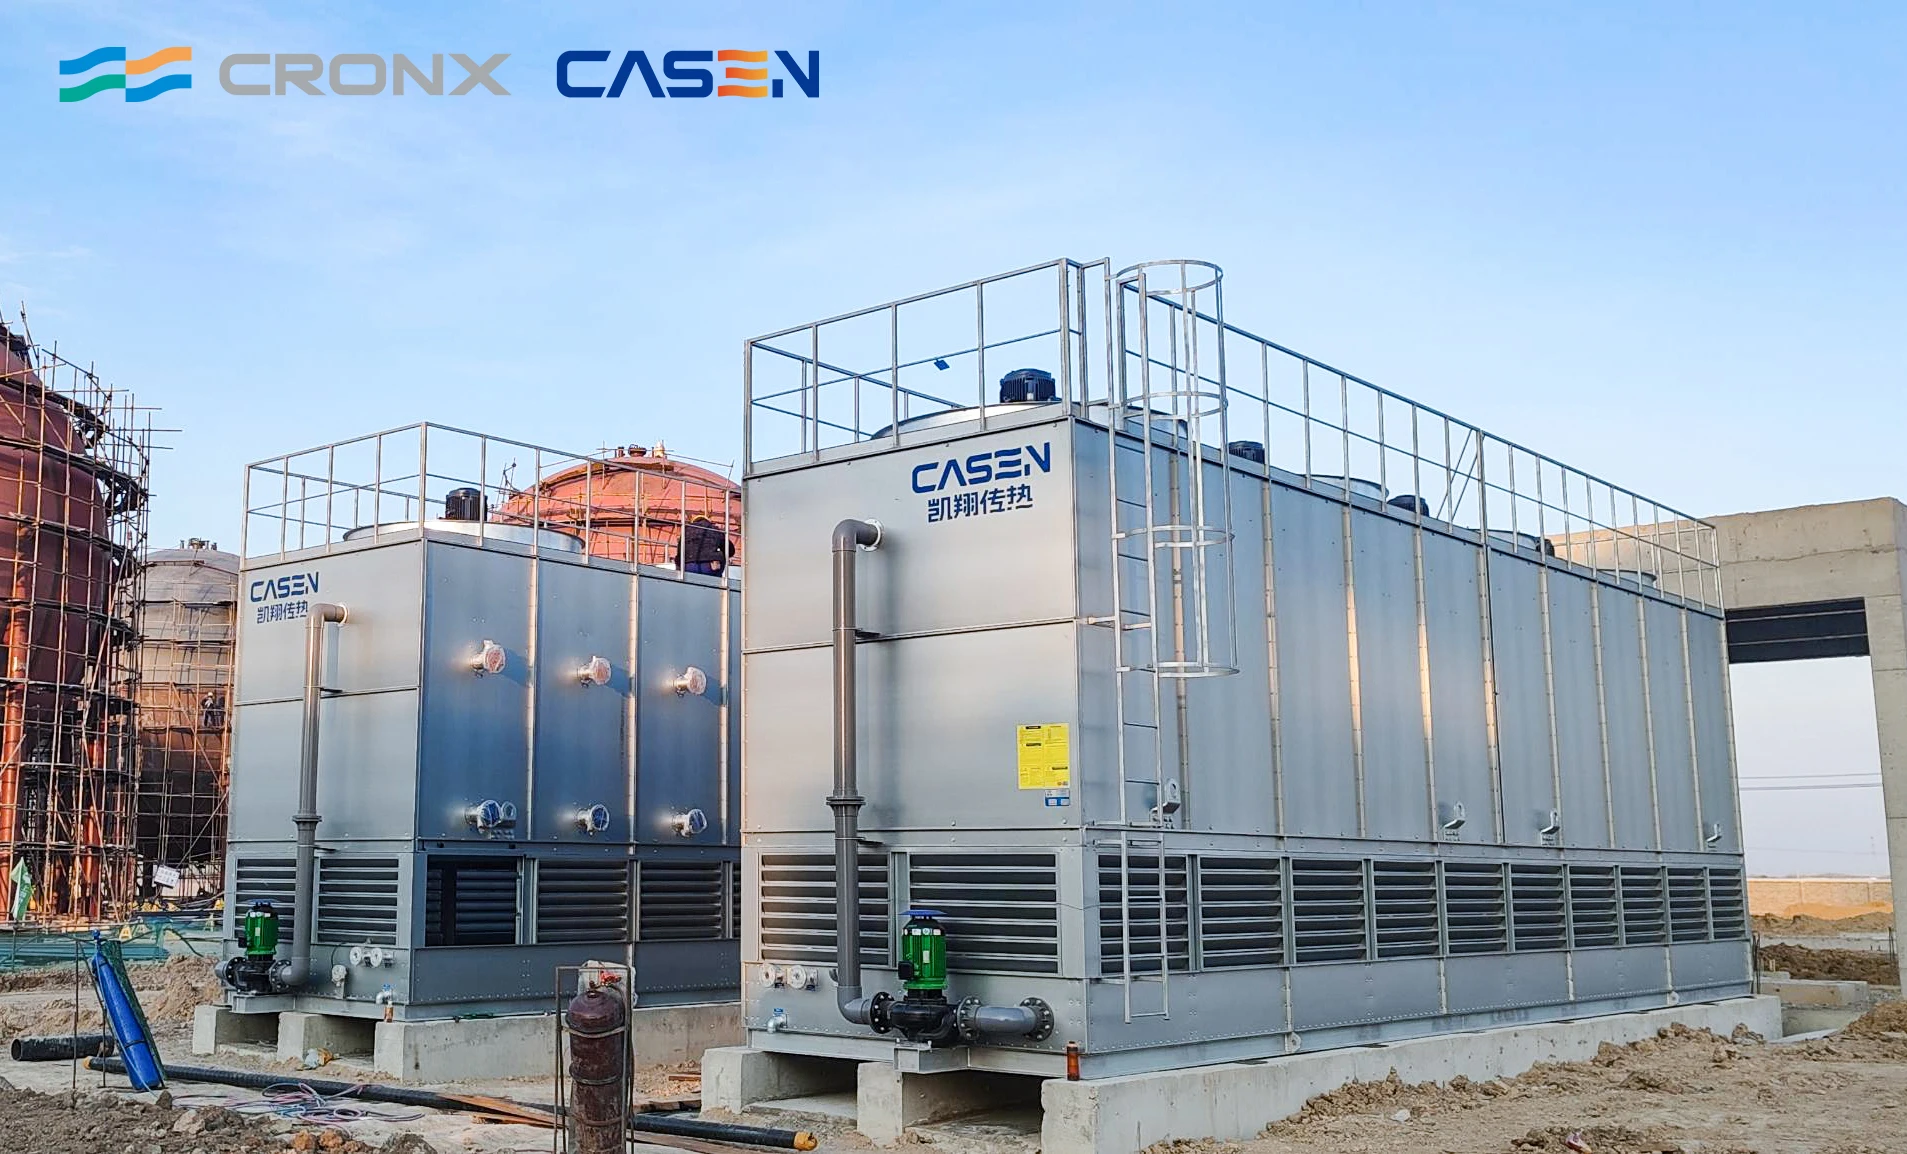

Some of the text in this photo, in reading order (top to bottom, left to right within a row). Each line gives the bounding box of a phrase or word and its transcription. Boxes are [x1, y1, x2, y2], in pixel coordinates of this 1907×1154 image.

[912, 442, 1051, 493] CASEN
[928, 484, 1033, 523] 凯翔传热
[250, 572, 319, 602] CASEN
[257, 600, 308, 624] 凯翔传热
